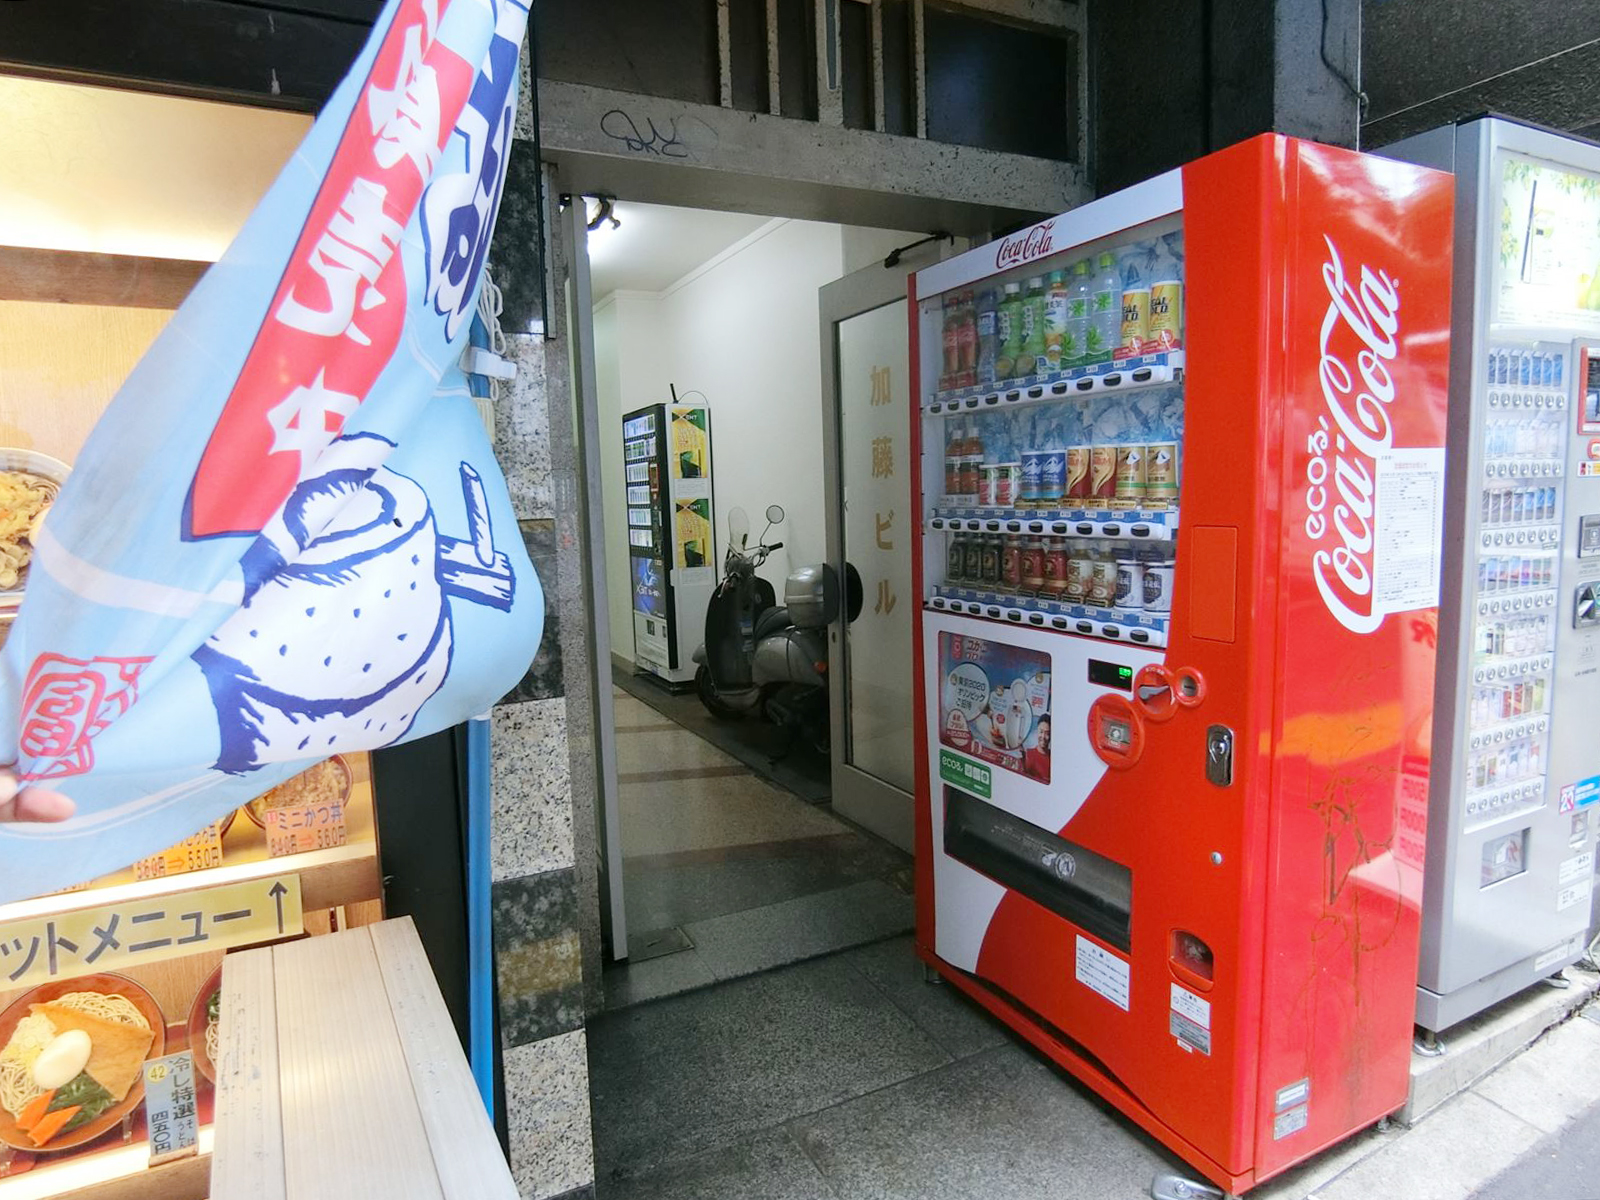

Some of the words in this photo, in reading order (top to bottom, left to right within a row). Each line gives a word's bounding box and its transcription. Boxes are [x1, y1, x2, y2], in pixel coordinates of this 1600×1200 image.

[996, 220, 1056, 269] Coca-Cola
[1312, 233, 1400, 635] Coca-Cola
[870, 365, 896, 615] 加藤ビル
[278, 804, 344, 830] ミニかつ丼
[316, 825, 346, 848] 560円
[187, 846, 219, 870] 550円
[0, 909, 252, 982] ットメニュー
[150, 1066, 166, 1080] 42
[169, 1057, 196, 1121] 冷し特選
